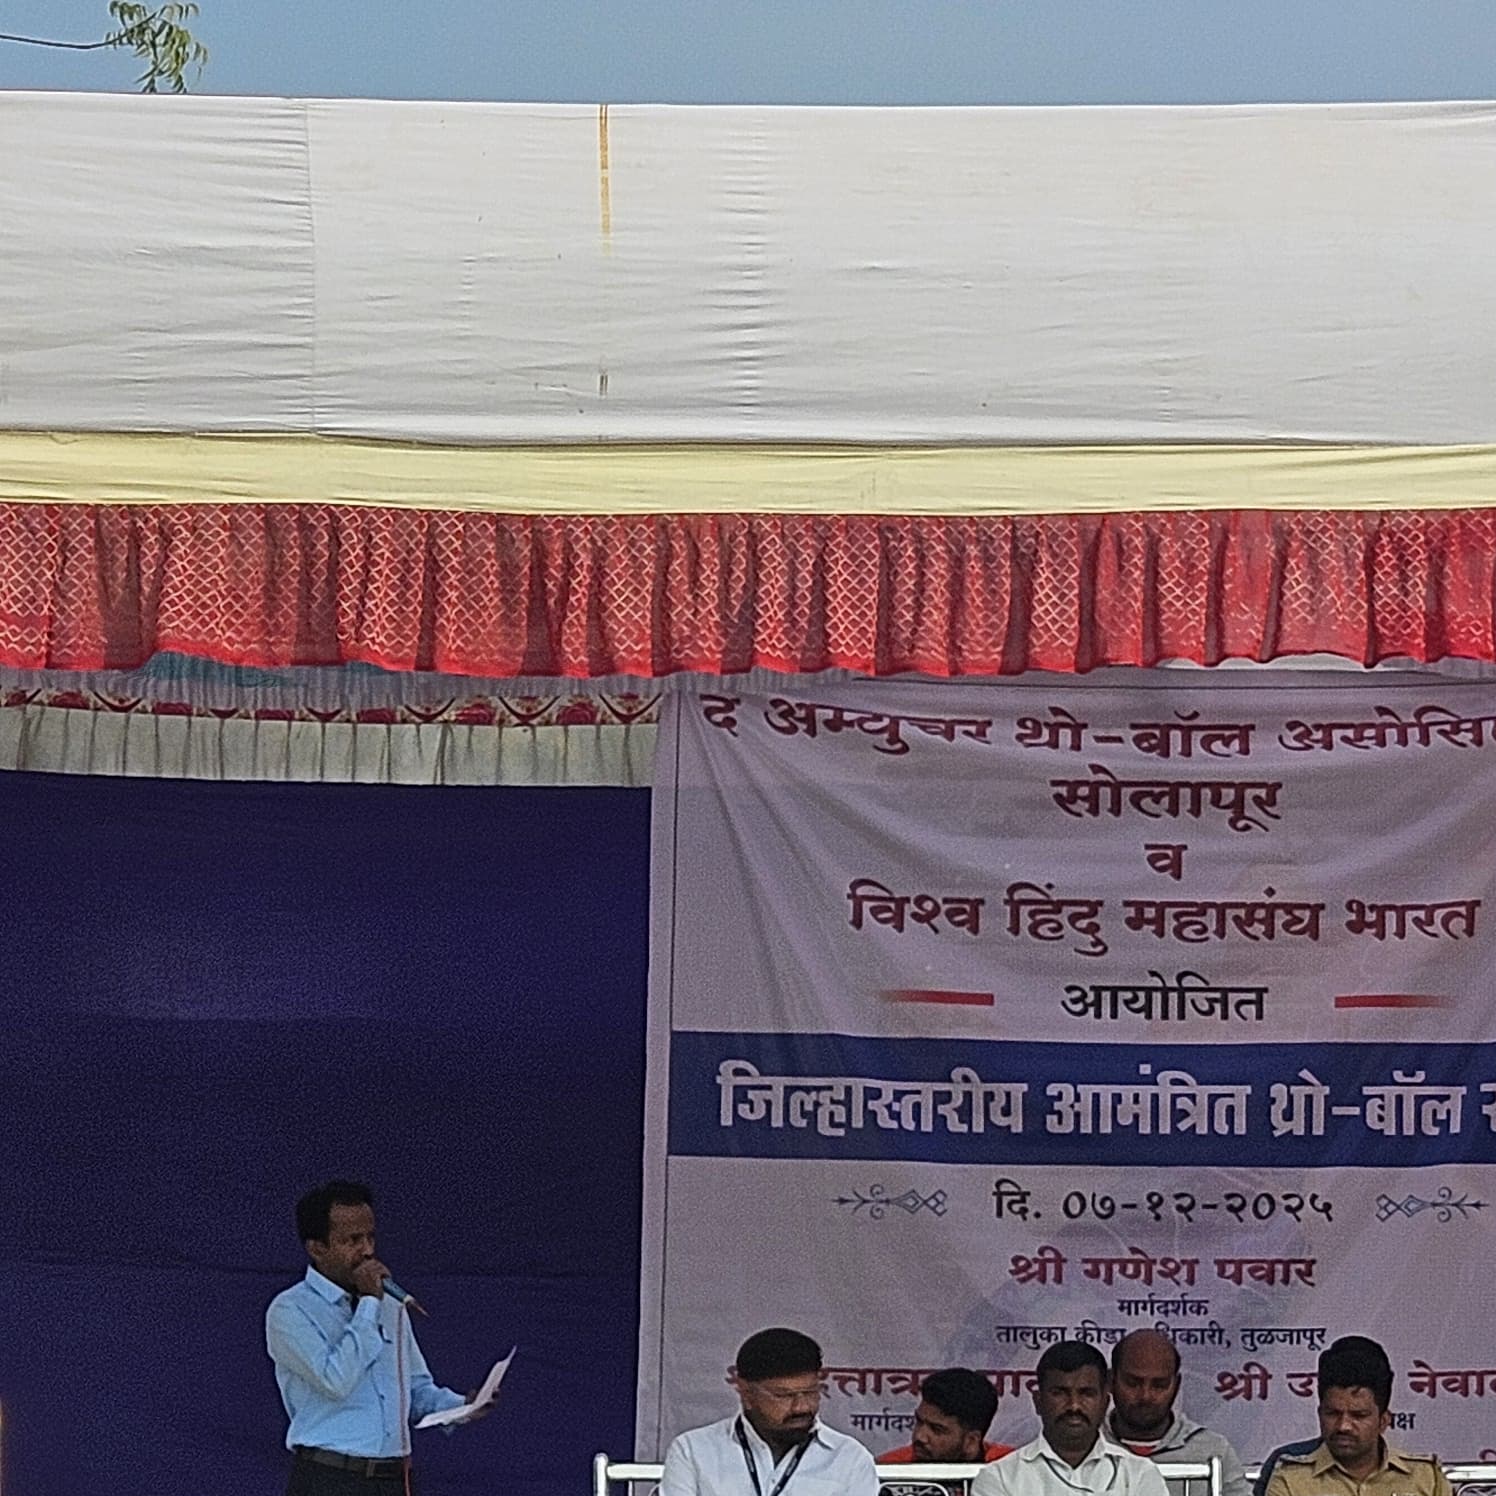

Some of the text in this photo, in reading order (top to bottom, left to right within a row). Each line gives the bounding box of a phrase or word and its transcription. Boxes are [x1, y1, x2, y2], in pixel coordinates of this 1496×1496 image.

[699, 694, 742, 737] द
[1050, 763, 1283, 832] सोलापूर
[1145, 842, 1187, 880] व
[848, 878, 1482, 956] विश्व हिंदु महासंघ भारत
[1061, 970, 1269, 1022] आयोजित
[716, 1059, 1028, 1137] जिल्हास्तरीय
[1046, 1063, 1252, 1135] आमंत्रित
[1009, 1245, 1317, 1288] श्री गणेश पवार
[1118, 1293, 1210, 1317] मार्गदर्शक
[996, 1325, 1067, 1350] तालुका
[1240, 1328, 1327, 1351] तुळजापूर
[1214, 1362, 1273, 1401] श्री
